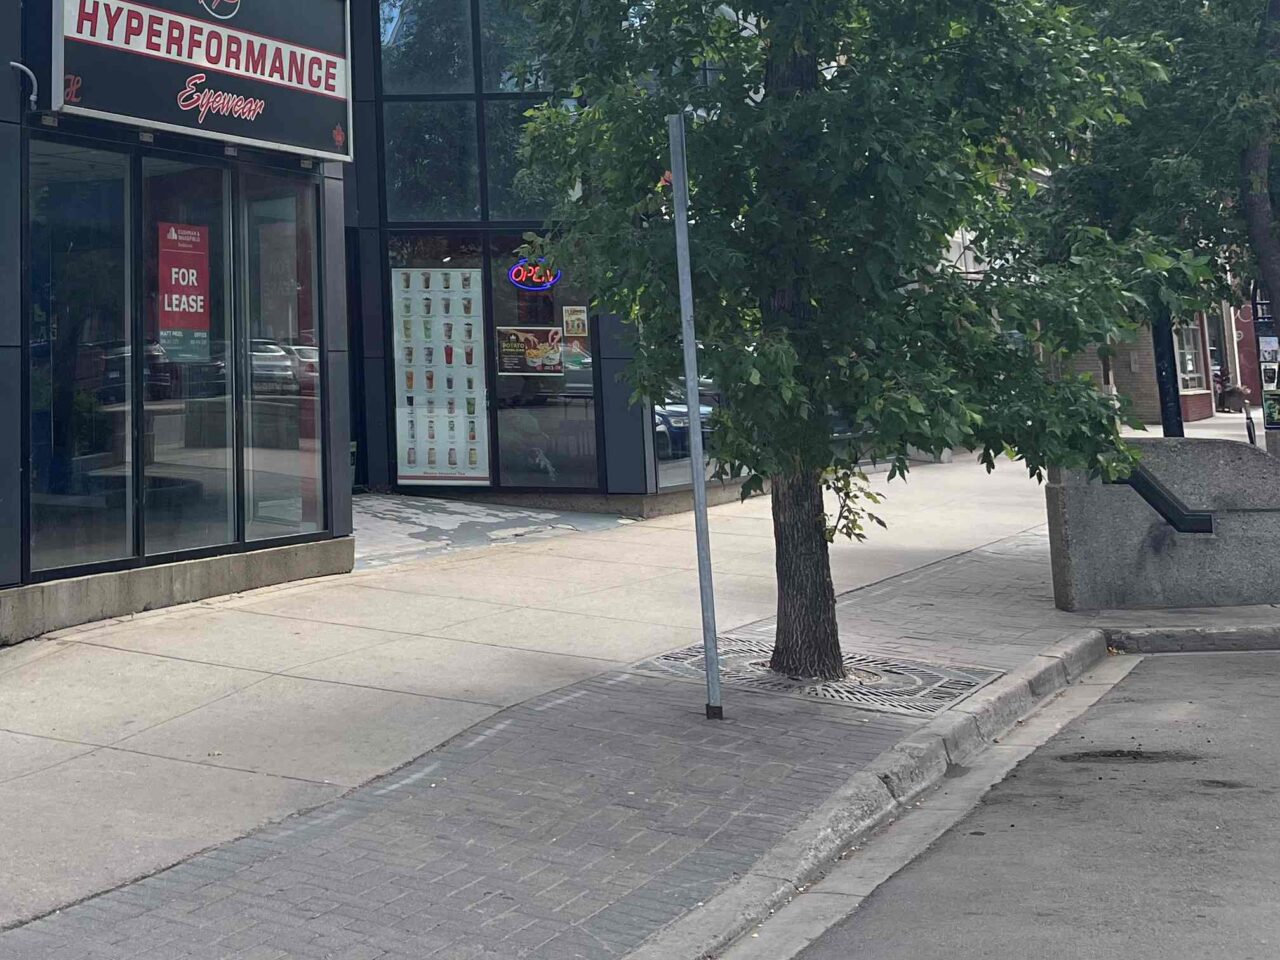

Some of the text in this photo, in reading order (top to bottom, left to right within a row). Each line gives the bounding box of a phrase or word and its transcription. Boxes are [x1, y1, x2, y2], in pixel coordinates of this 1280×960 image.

[177, 73, 265, 123] Eyewear
[171, 268, 198, 286] FOR
[164, 294, 204, 312] LEASE
